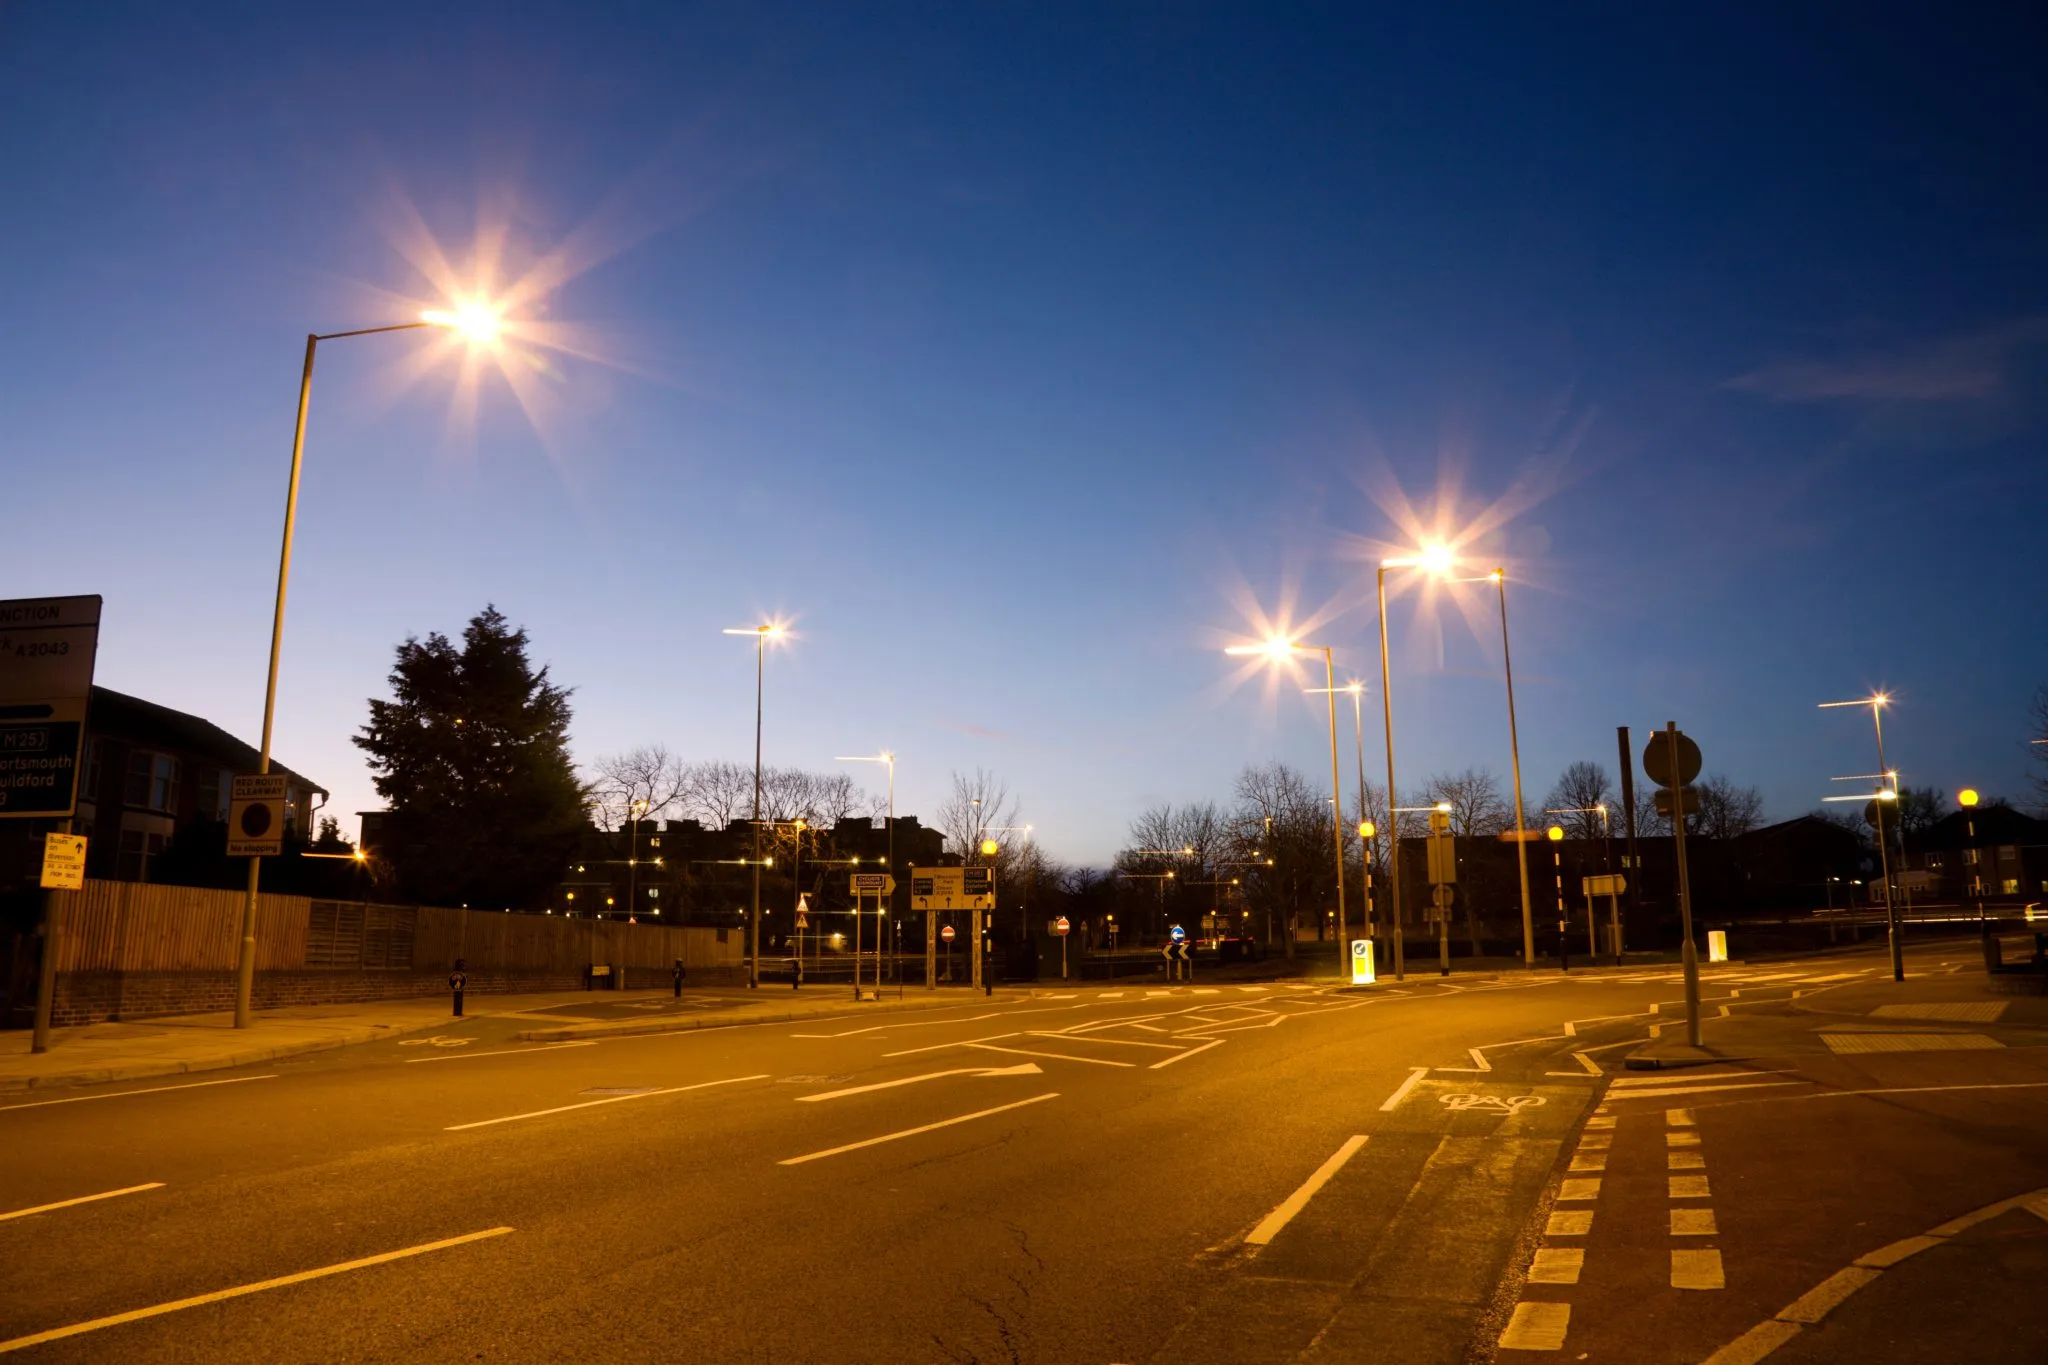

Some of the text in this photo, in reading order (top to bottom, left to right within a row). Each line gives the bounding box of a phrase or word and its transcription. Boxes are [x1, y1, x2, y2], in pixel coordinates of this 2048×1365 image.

[16, 641, 69, 657] A2043
[236, 778, 283, 787] RED ROUTE
[236, 787, 283, 796] CLEARWAY
[230, 844, 278, 853] No stopping
